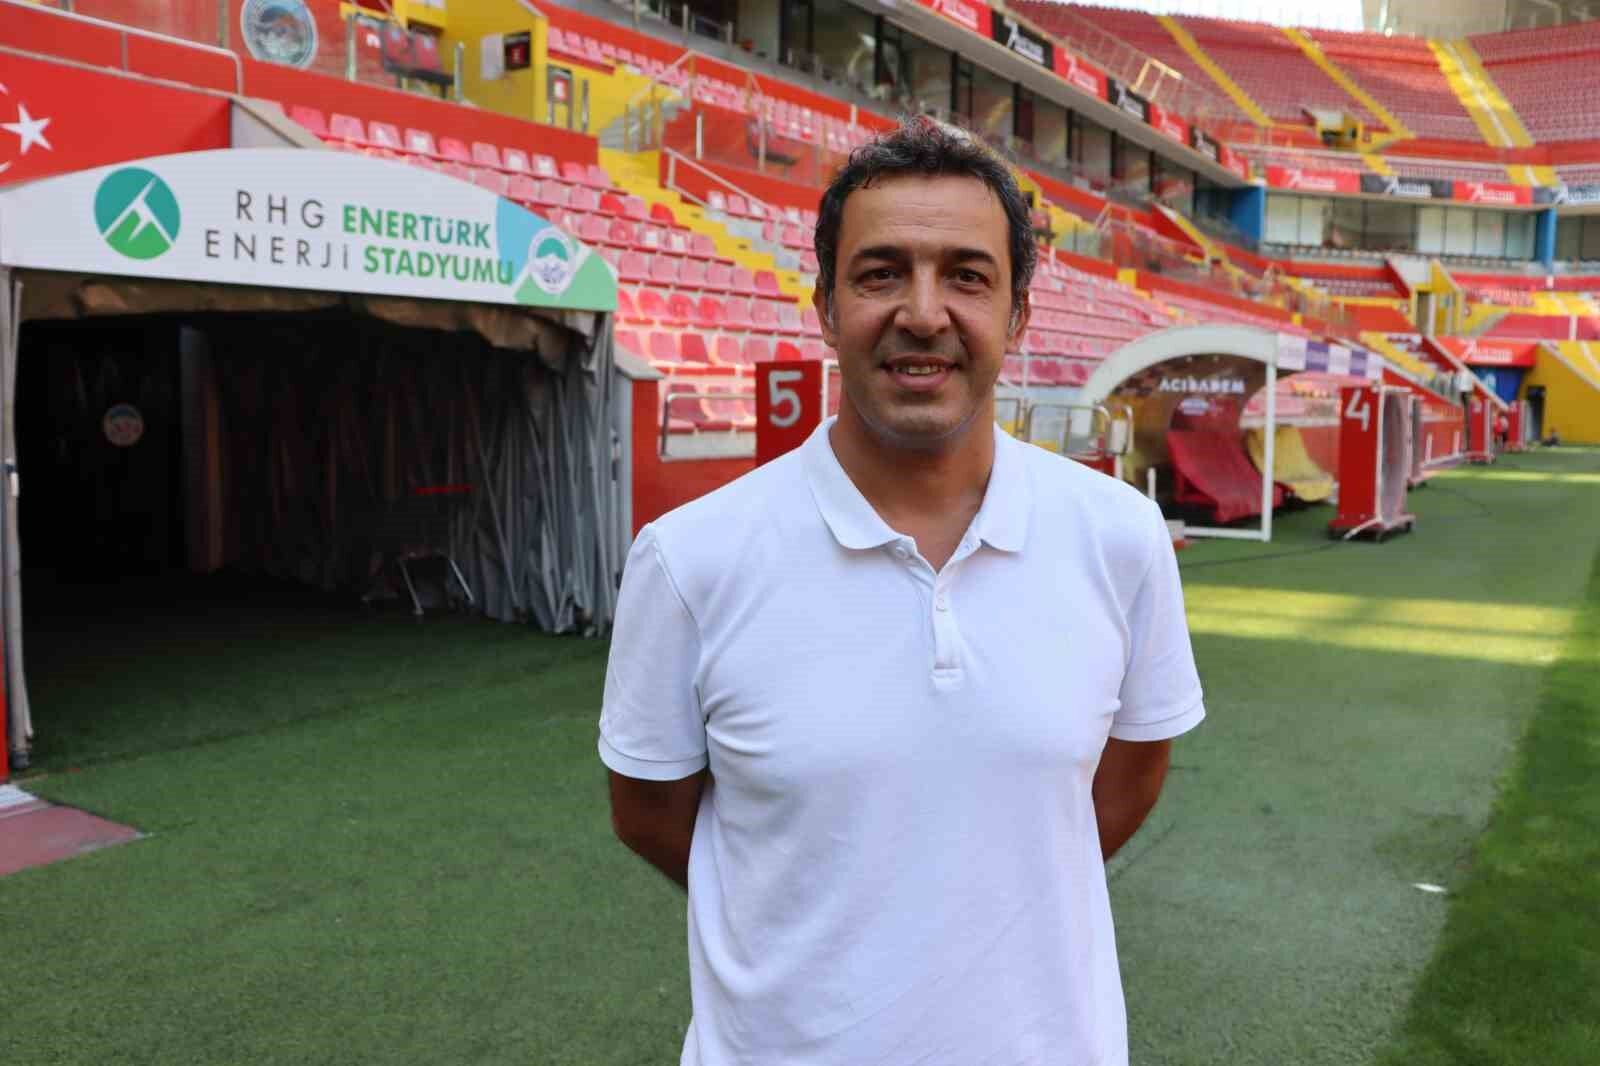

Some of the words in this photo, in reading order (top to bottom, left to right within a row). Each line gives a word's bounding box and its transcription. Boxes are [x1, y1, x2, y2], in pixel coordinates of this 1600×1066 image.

[236, 189, 325, 229] RHG
[363, 245, 514, 286] STADYUMU
[768, 369, 803, 428] 5
[1345, 388, 1371, 432] 4
